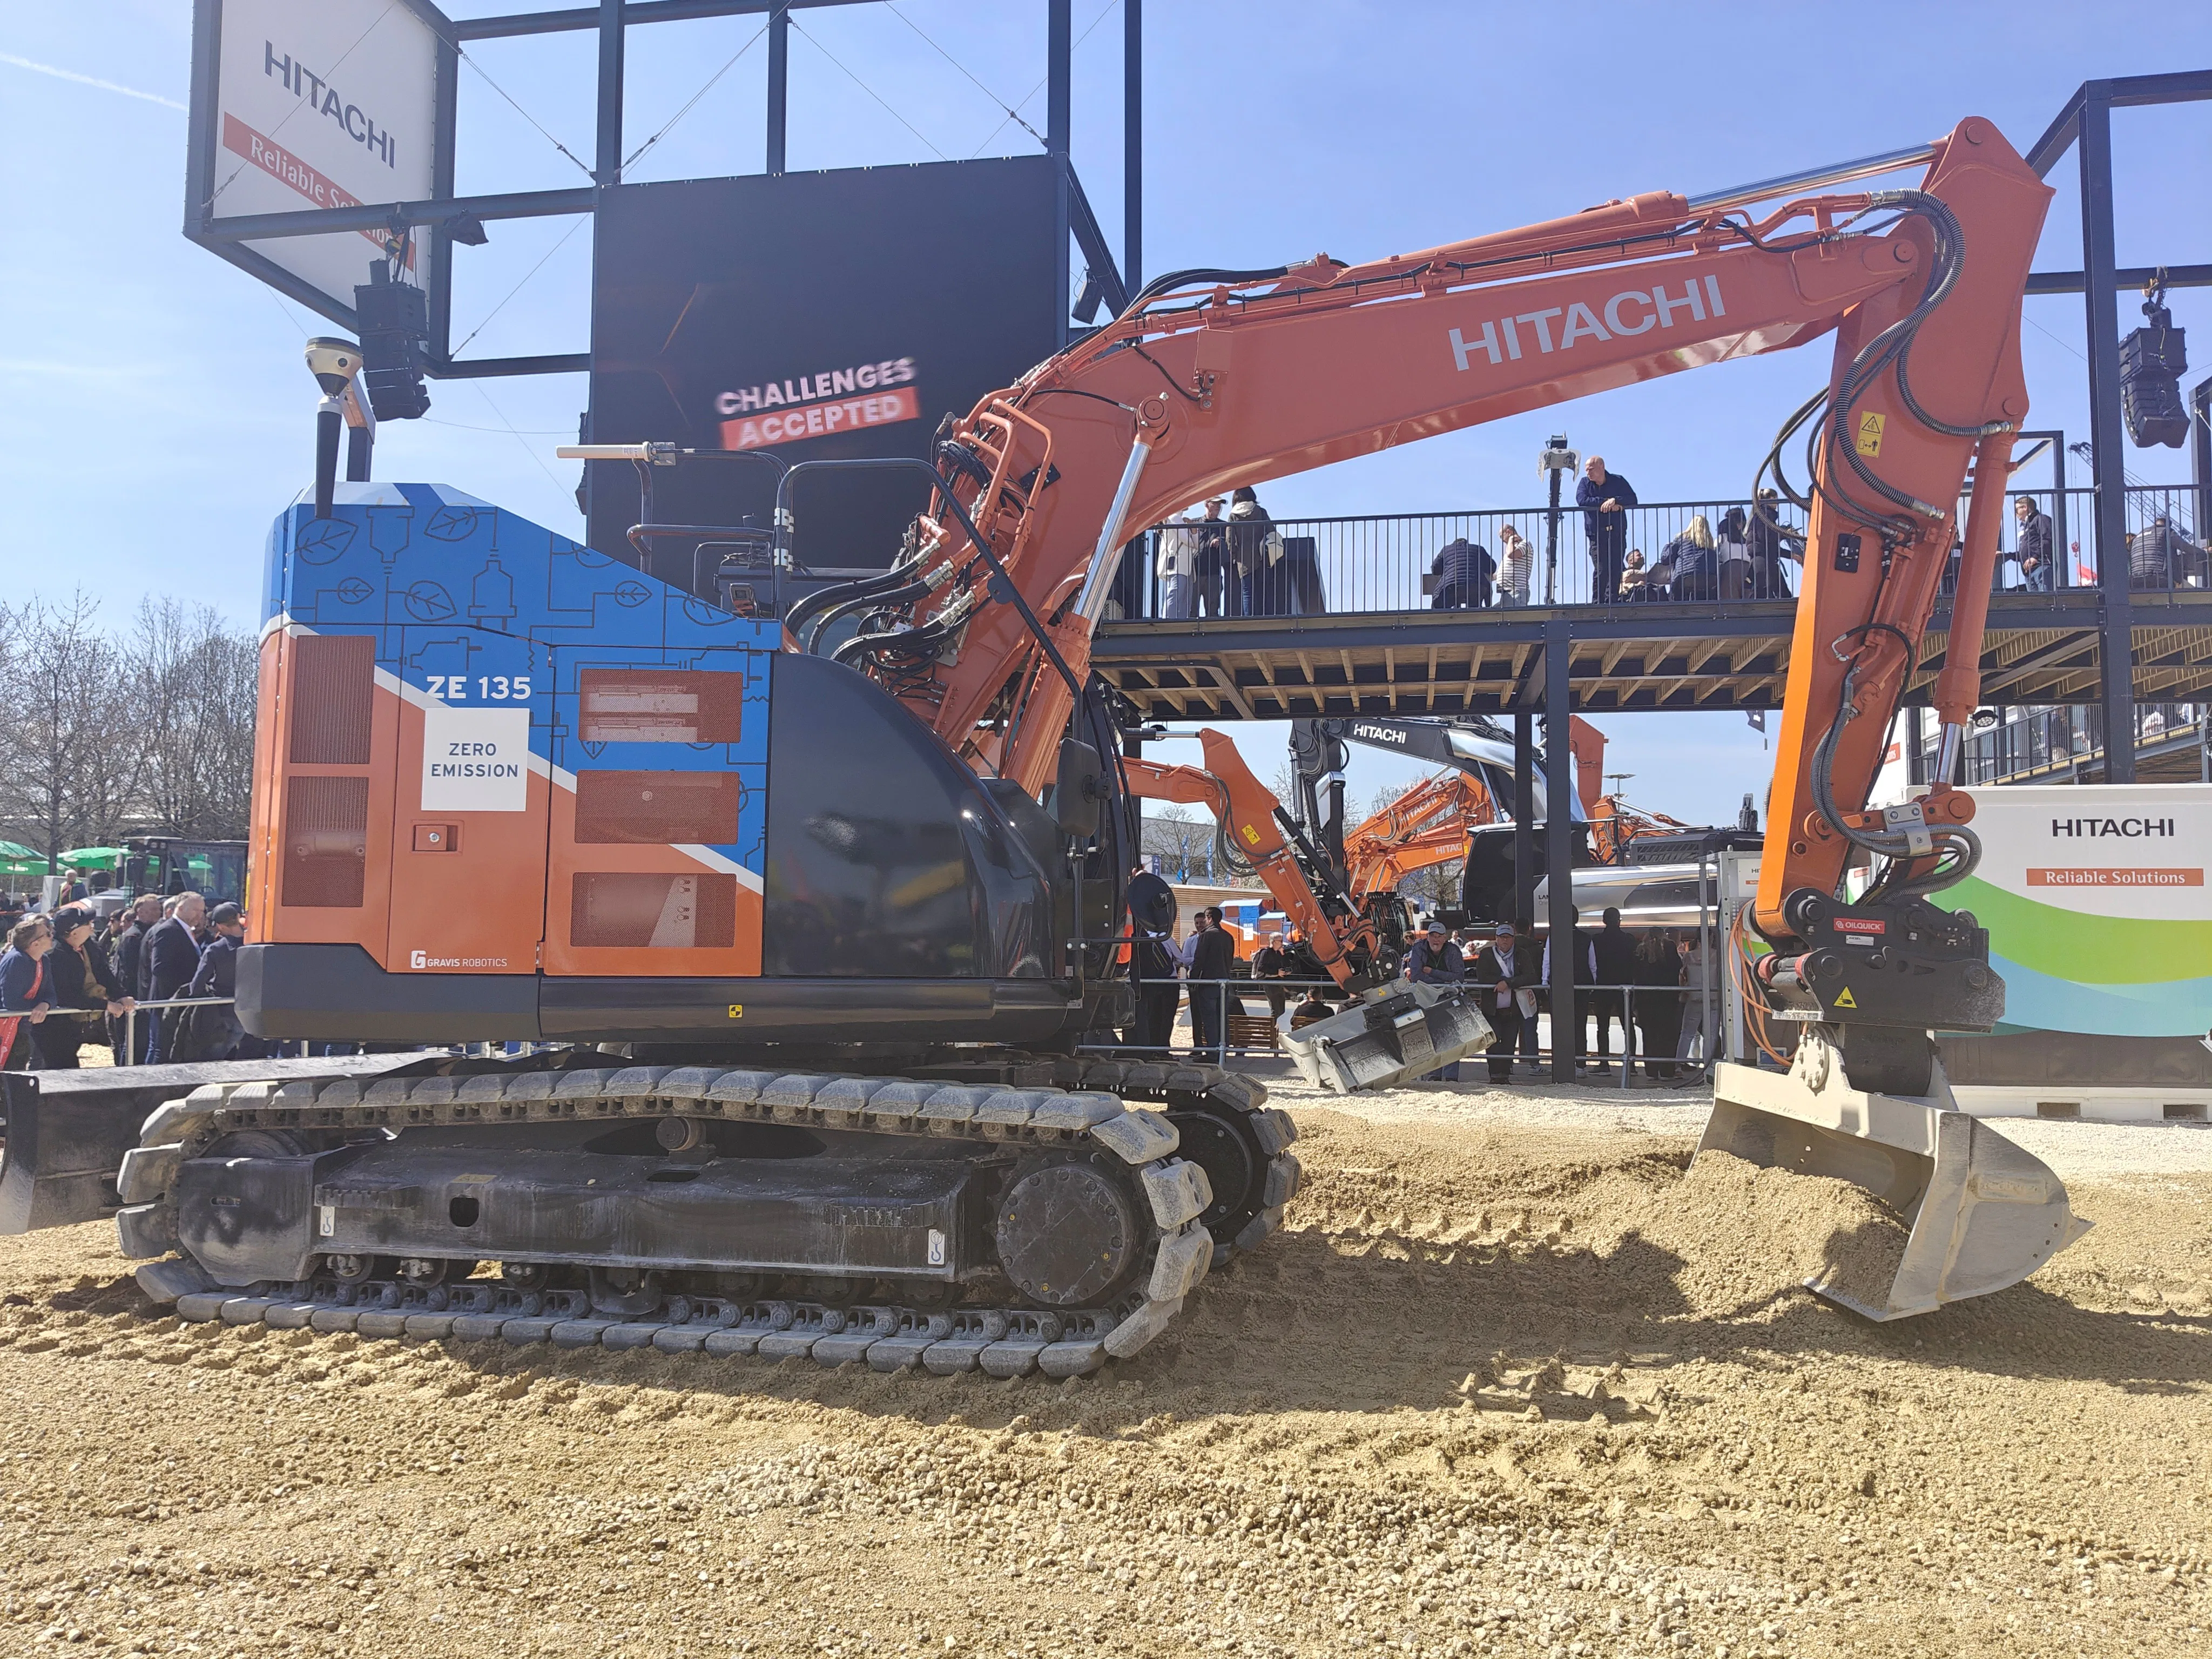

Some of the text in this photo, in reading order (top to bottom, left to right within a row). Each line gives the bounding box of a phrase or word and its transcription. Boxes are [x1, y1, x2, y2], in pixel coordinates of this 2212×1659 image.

[265, 39, 395, 170] HITACHI
[249, 133, 325, 201] Reliable
[1448, 274, 1725, 371] HITACHI
[716, 356, 915, 415] CHALLENGES
[739, 395, 902, 449] ACCEPTED
[426, 676, 531, 699] ZE 135
[1353, 723, 1406, 744] HITACHI
[449, 743, 496, 756] ZERO
[431, 764, 518, 777] EMISSION
[2052, 818, 2174, 837] HITACHI
[1435, 842, 1462, 855] HITAC
[2045, 871, 2186, 884] Reliable Solutions
[1845, 921, 1881, 930] OILQUICK
[427, 959, 460, 967] GRAVIS
[462, 959, 507, 967] ROBOTICS
